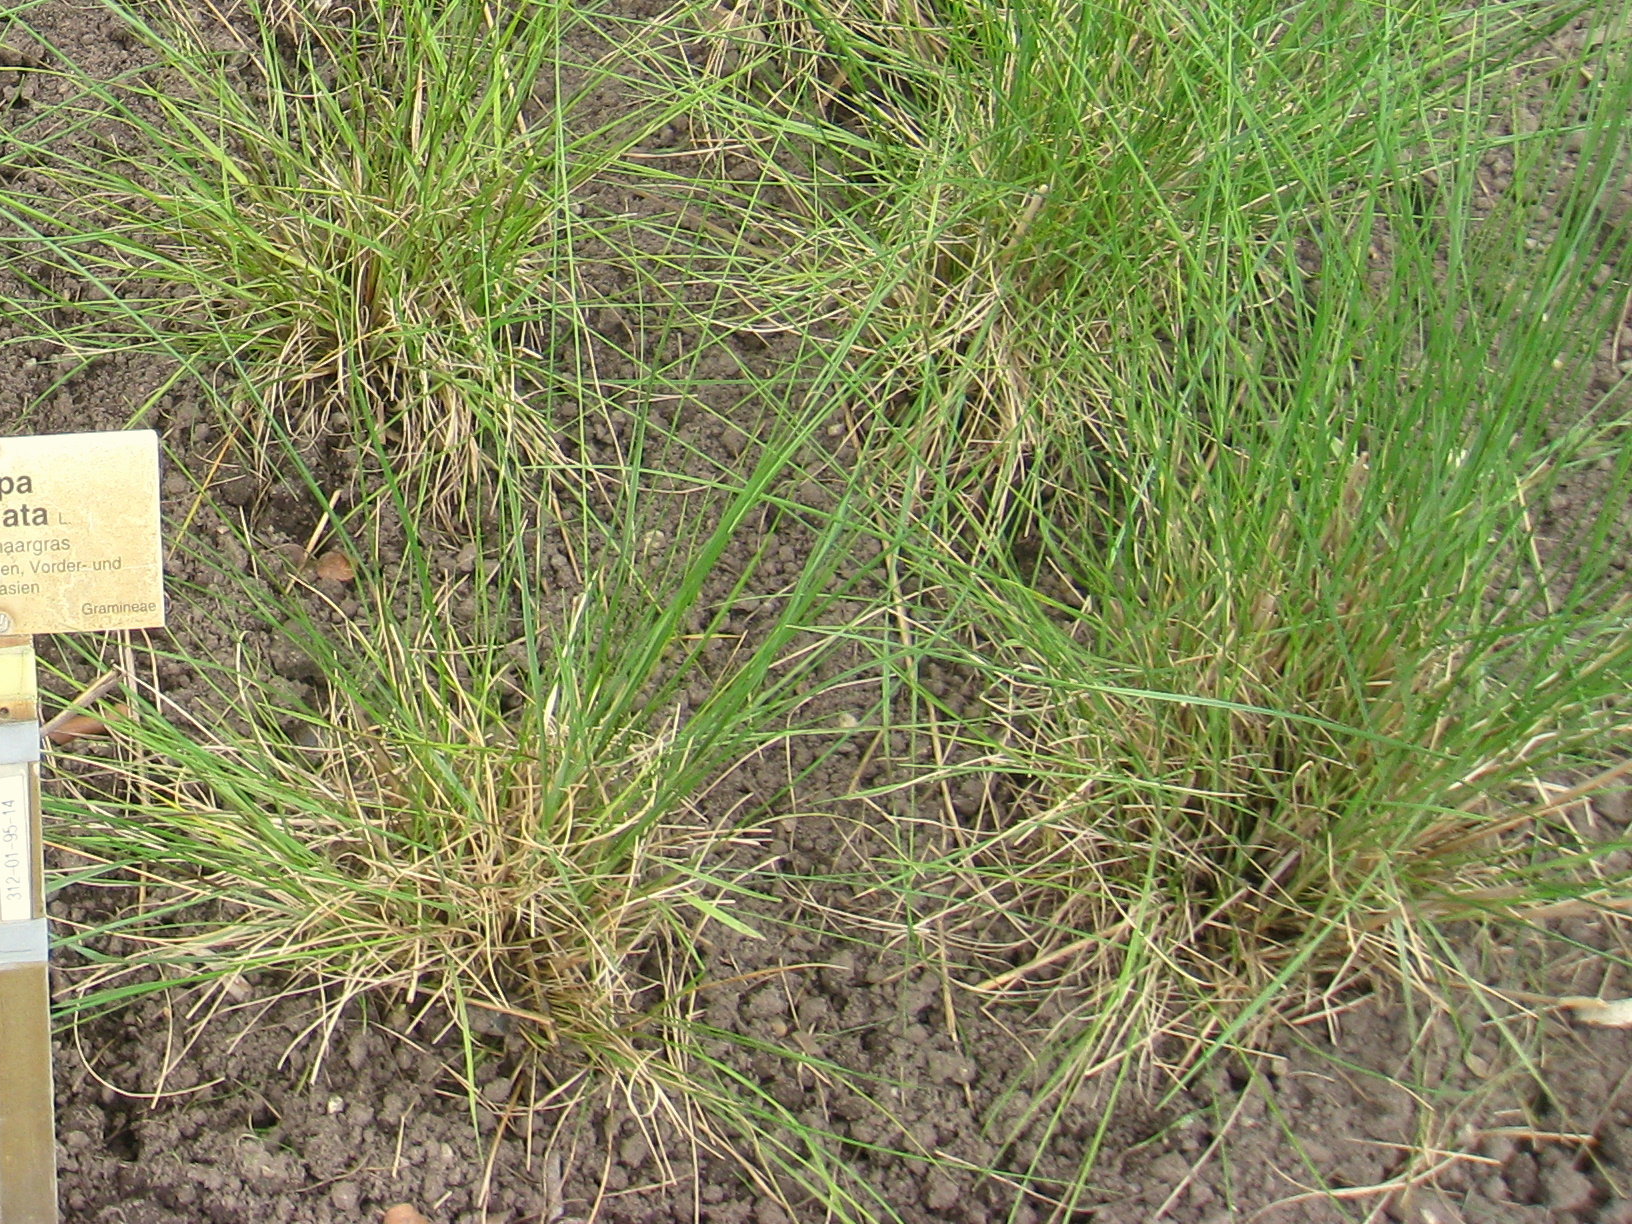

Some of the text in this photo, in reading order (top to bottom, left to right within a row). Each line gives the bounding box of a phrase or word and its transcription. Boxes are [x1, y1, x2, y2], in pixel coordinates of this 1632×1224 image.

[58, 512, 72, 526] L.
[29, 559, 87, 575] Vorder-
[92, 557, 122, 572] und
[81, 600, 157, 616] Gramineae
[1, 799, 22, 901] 312-01-95-14
